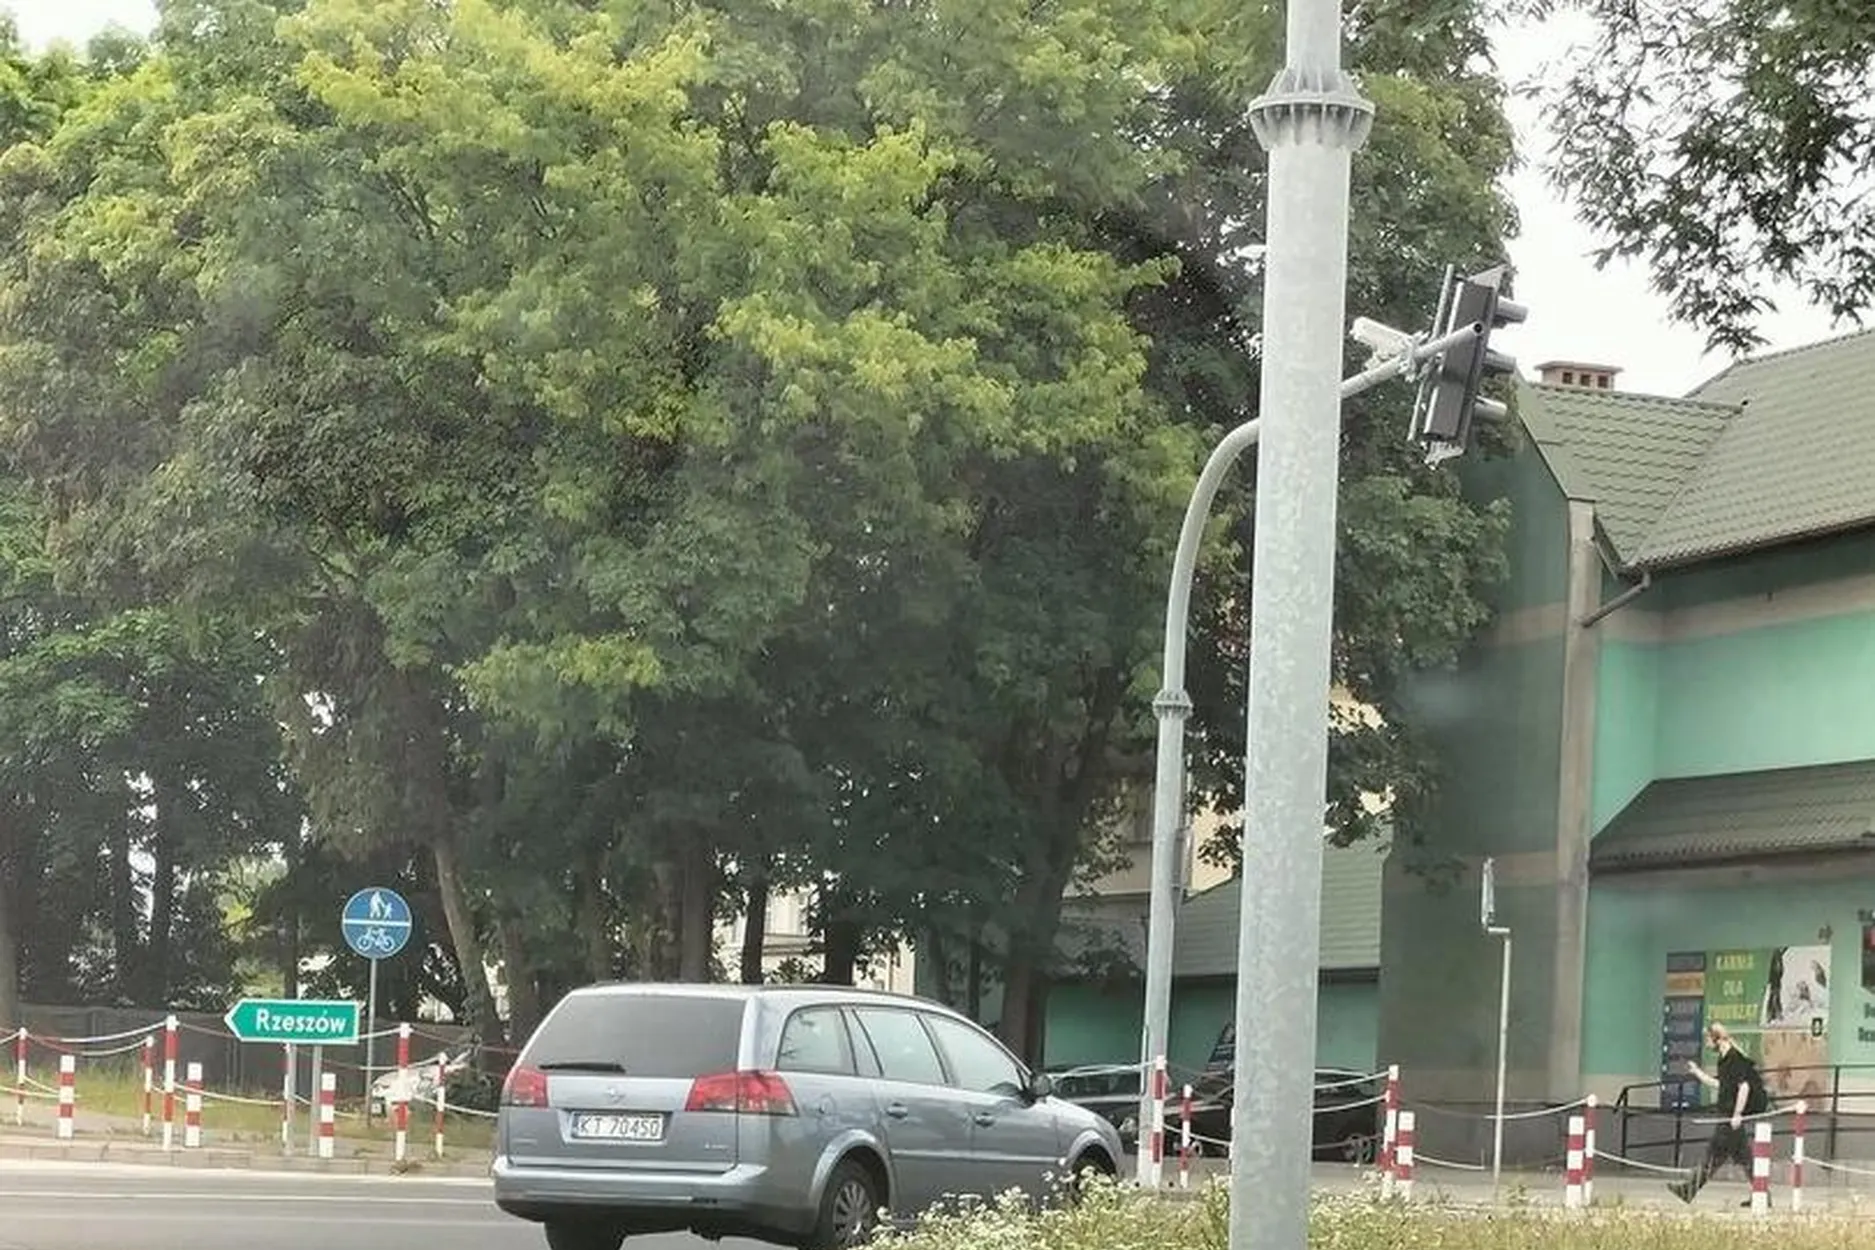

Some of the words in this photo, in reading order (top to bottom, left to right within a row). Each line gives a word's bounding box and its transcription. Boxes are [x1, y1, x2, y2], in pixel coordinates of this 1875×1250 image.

[255, 1007, 347, 1034] Rzeszów
[580, 1116, 603, 1134] KT
[609, 1117, 661, 1137] 70450
